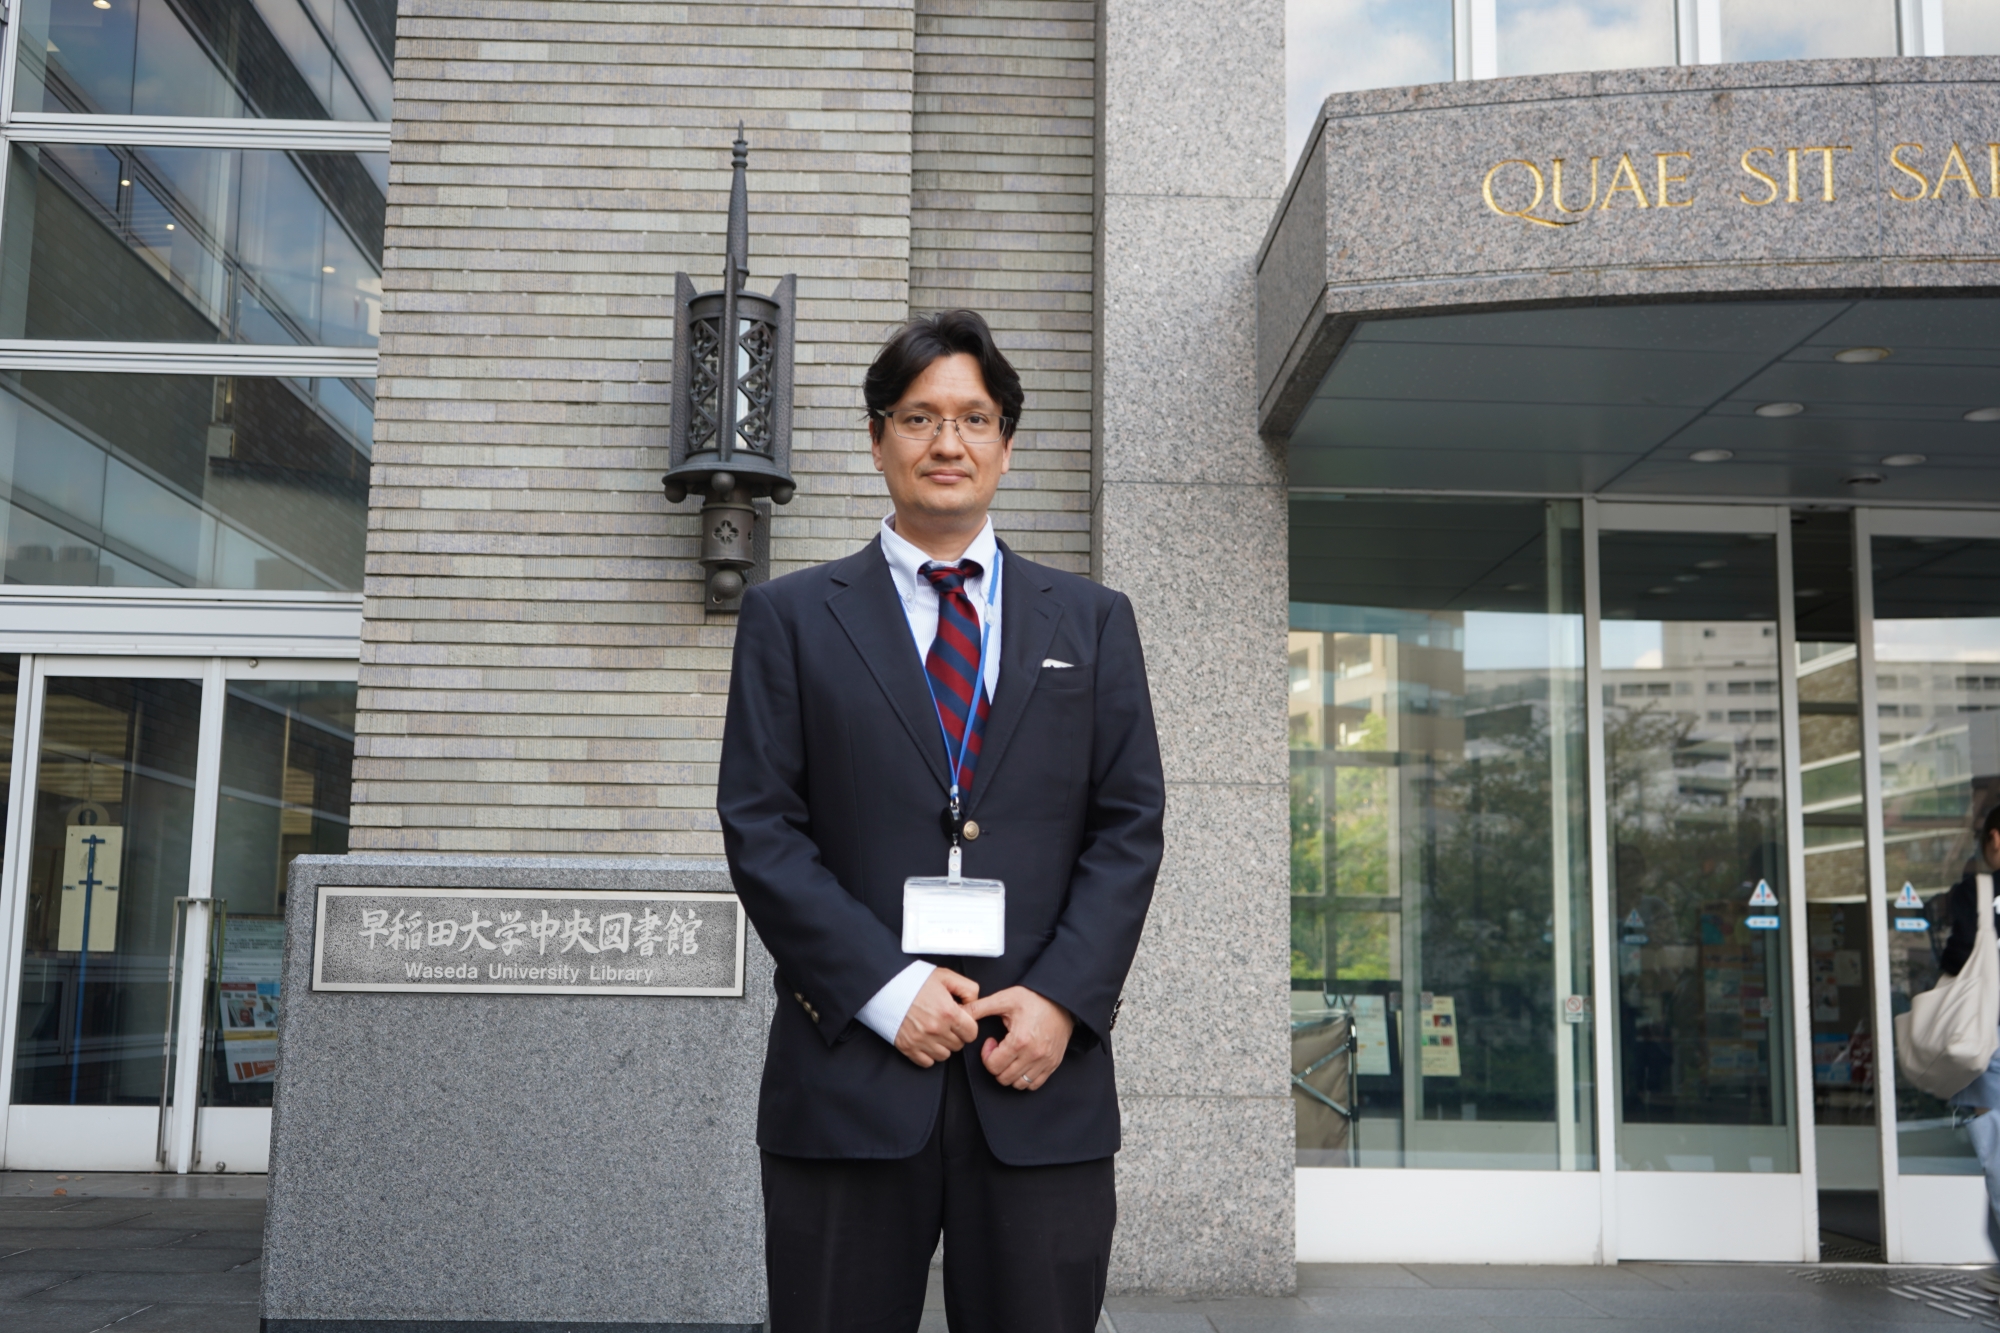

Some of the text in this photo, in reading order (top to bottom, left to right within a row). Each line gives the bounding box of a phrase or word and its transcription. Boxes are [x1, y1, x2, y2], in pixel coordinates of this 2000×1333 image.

[1482, 151, 1695, 228] QUAE
[1740, 144, 1853, 206] SIT
[358, 907, 703, 957] 早稲田大学中央図書館
[404, 962, 654, 984] Waseda University Library
